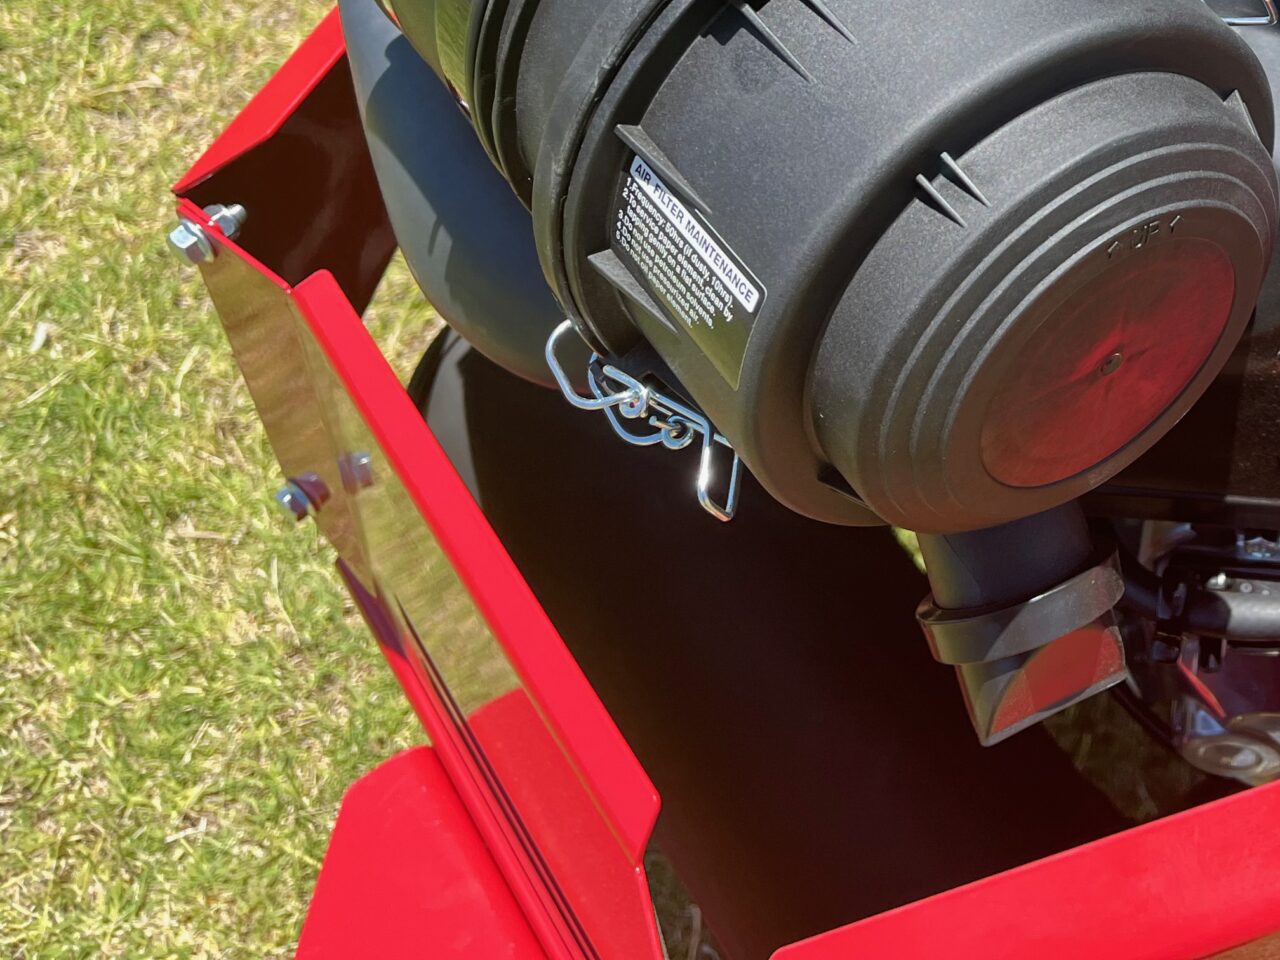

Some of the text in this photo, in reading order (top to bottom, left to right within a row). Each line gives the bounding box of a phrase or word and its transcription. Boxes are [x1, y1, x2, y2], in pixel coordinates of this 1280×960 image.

[636, 164, 752, 302] AIR FILTER MAINTENANCE
[705, 284, 723, 310] clean
